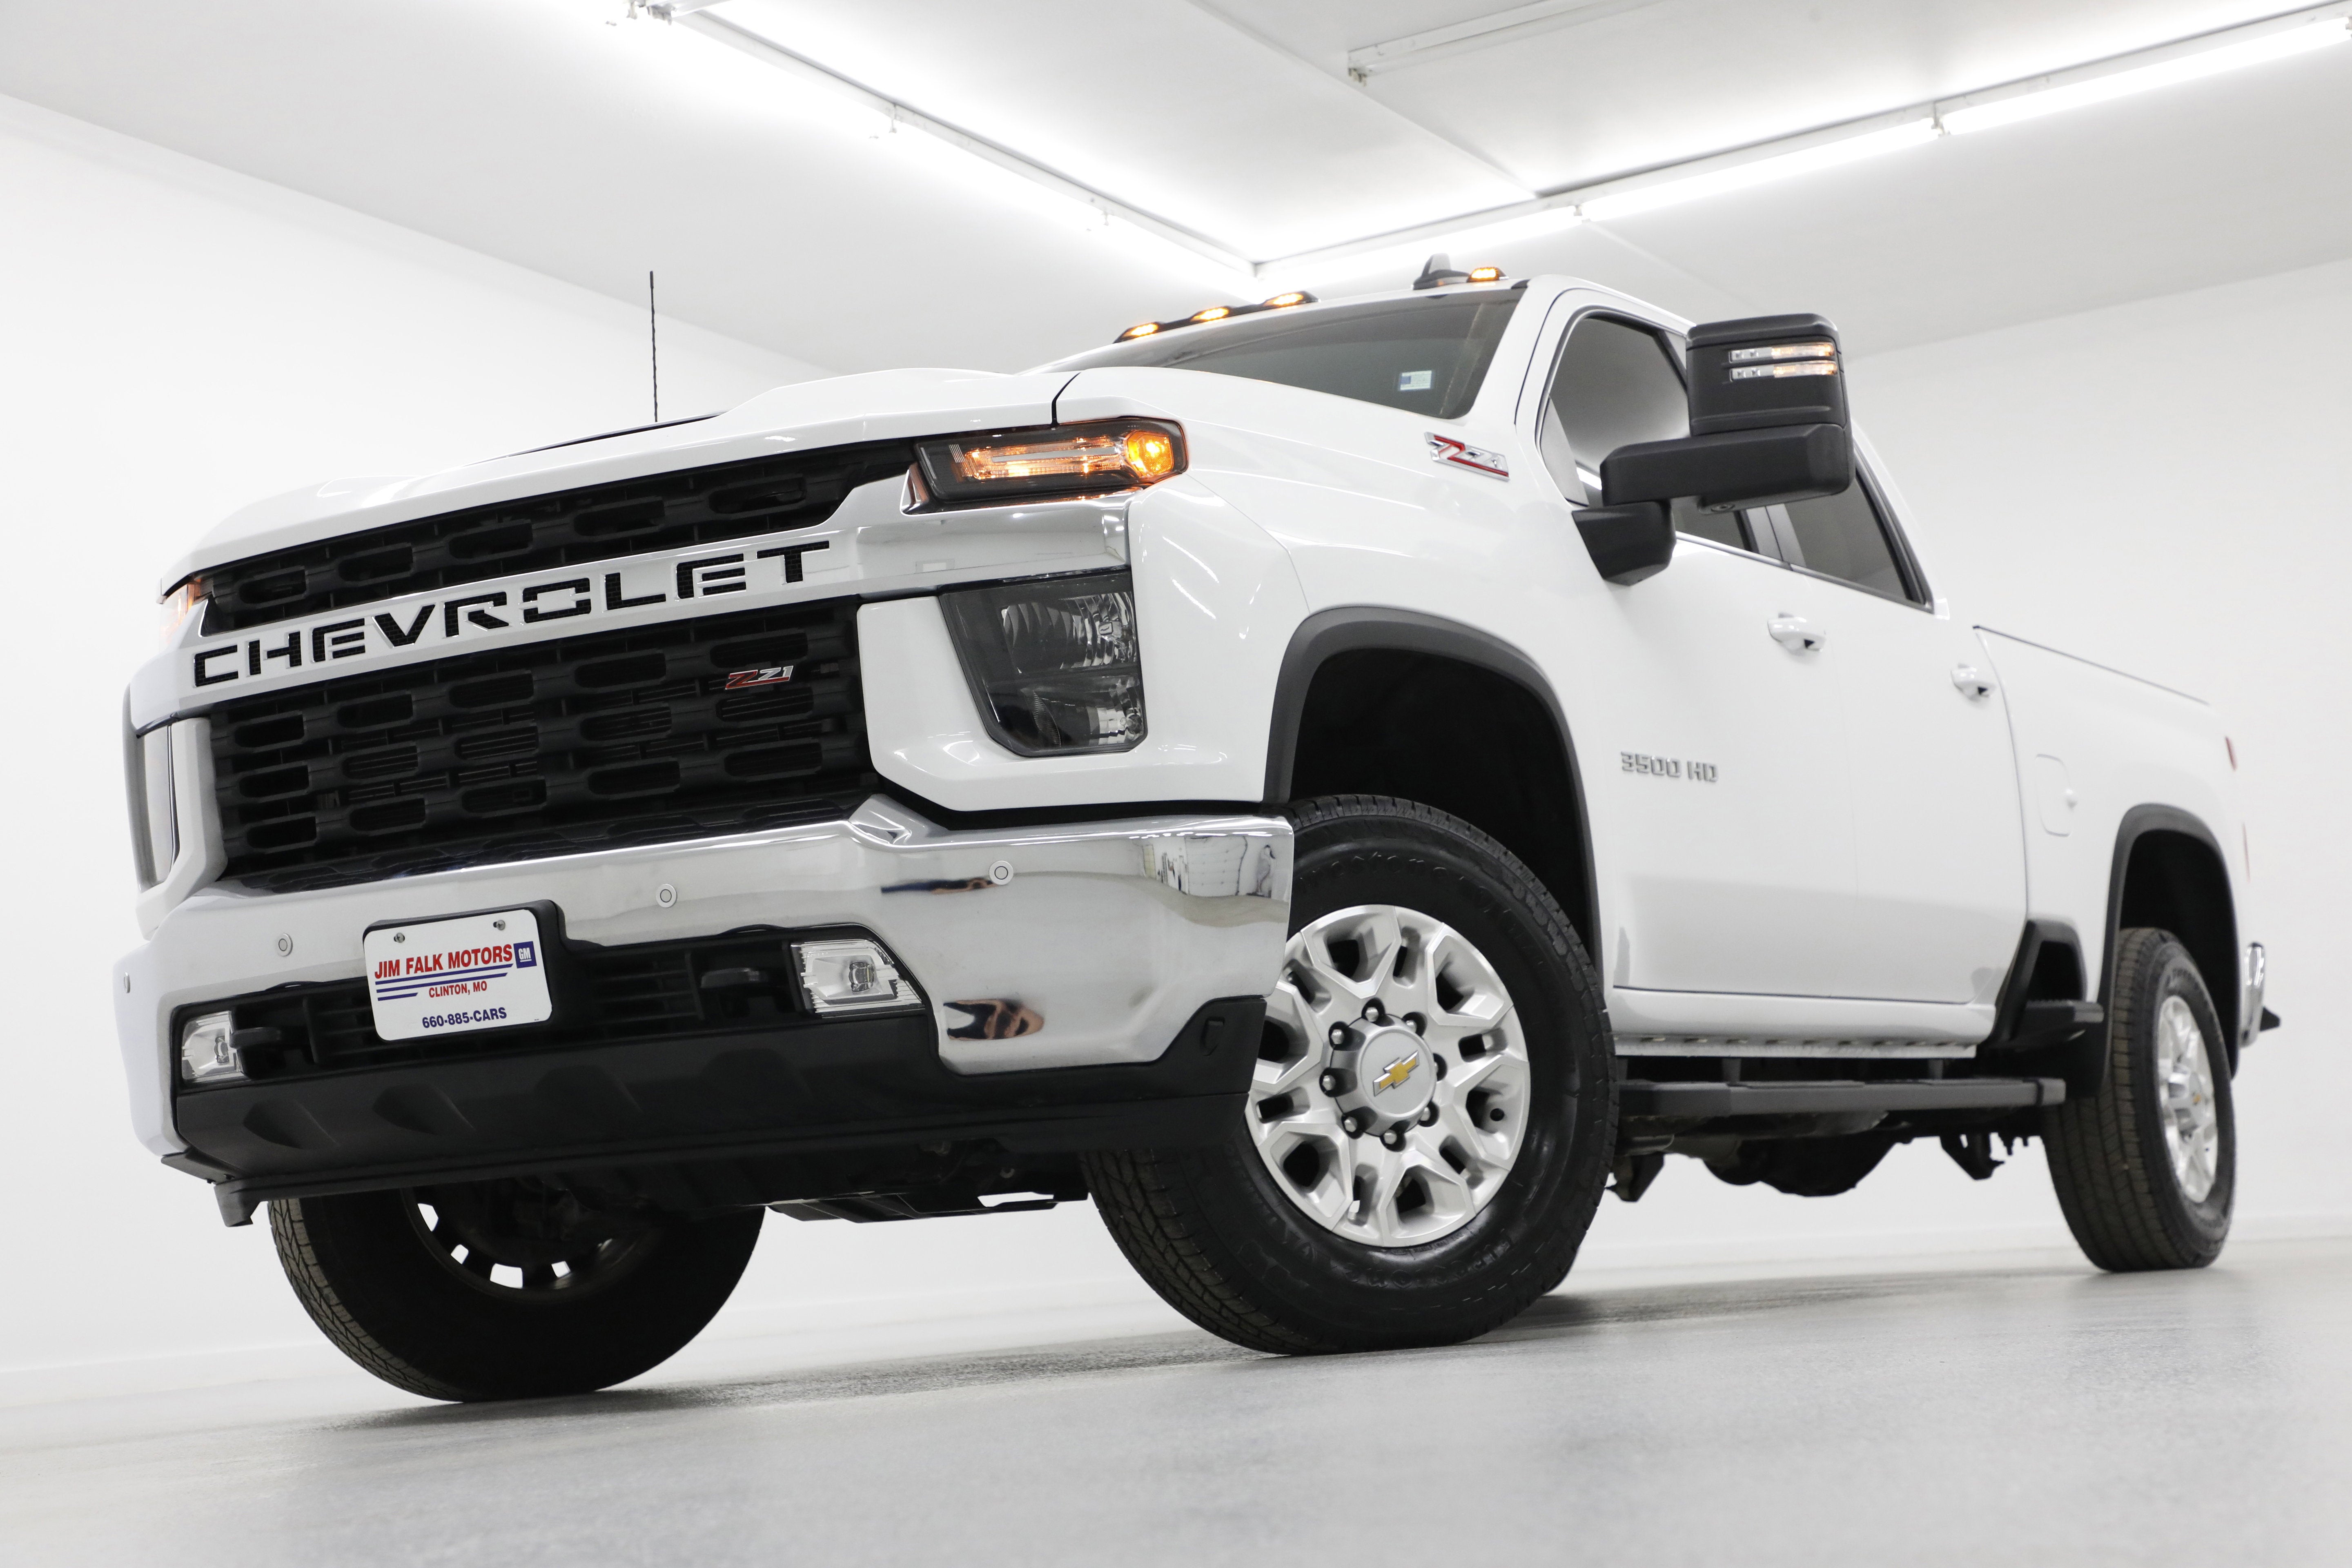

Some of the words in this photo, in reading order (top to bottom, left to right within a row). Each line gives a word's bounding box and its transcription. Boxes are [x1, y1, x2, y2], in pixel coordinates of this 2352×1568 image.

[1424, 431, 1510, 482] Z71
[194, 540, 830, 688] CHEVROLET
[725, 666, 794, 690] Z71
[1620, 751, 1682, 778] 3500
[1687, 760, 1719, 782] HD
[375, 959, 400, 979] JIM
[406, 953, 443, 976] FALK
[448, 944, 513, 969] MOTORS
[518, 947, 532, 961] GM
[429, 983, 471, 998] CLINTON,
[473, 980, 488, 992] MO
[422, 1007, 507, 1029] 660-885-CARS
